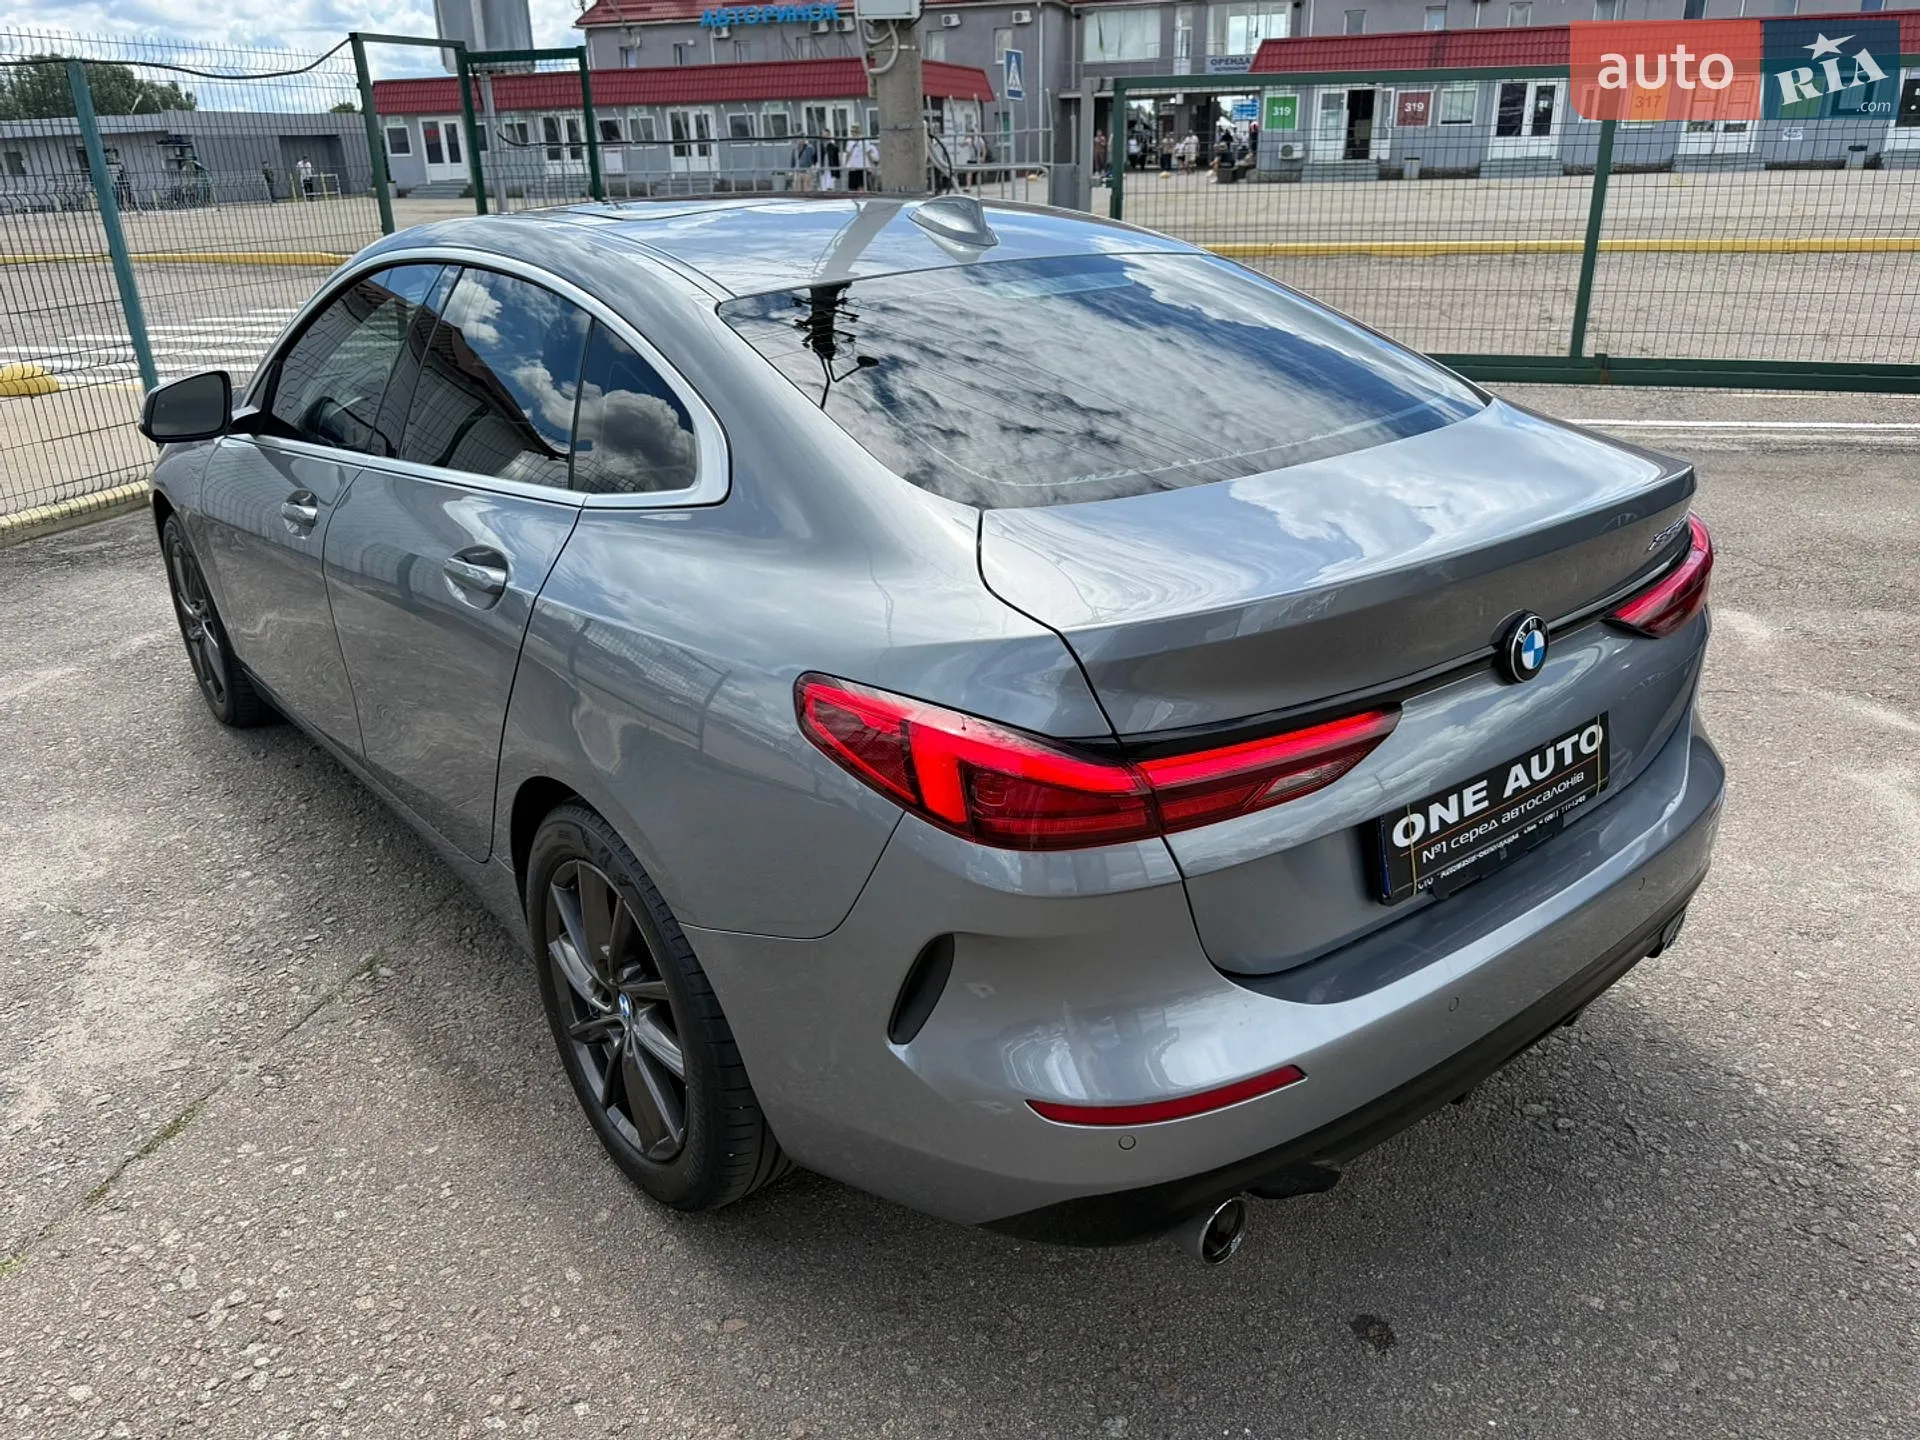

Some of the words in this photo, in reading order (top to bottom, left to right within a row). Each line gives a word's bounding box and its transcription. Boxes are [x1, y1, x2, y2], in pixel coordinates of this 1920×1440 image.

[701, 3, 841, 28] АВТОРИНОК
[1210, 57, 1250, 66] ОРЕНДА
[1272, 106, 1292, 116] 319
[1404, 102, 1425, 112] 319
[1392, 779, 1490, 848] ONE
[1503, 724, 1604, 799] AUTO
[1450, 820, 1499, 849] серед
[1501, 771, 1585, 824] автосалонів
